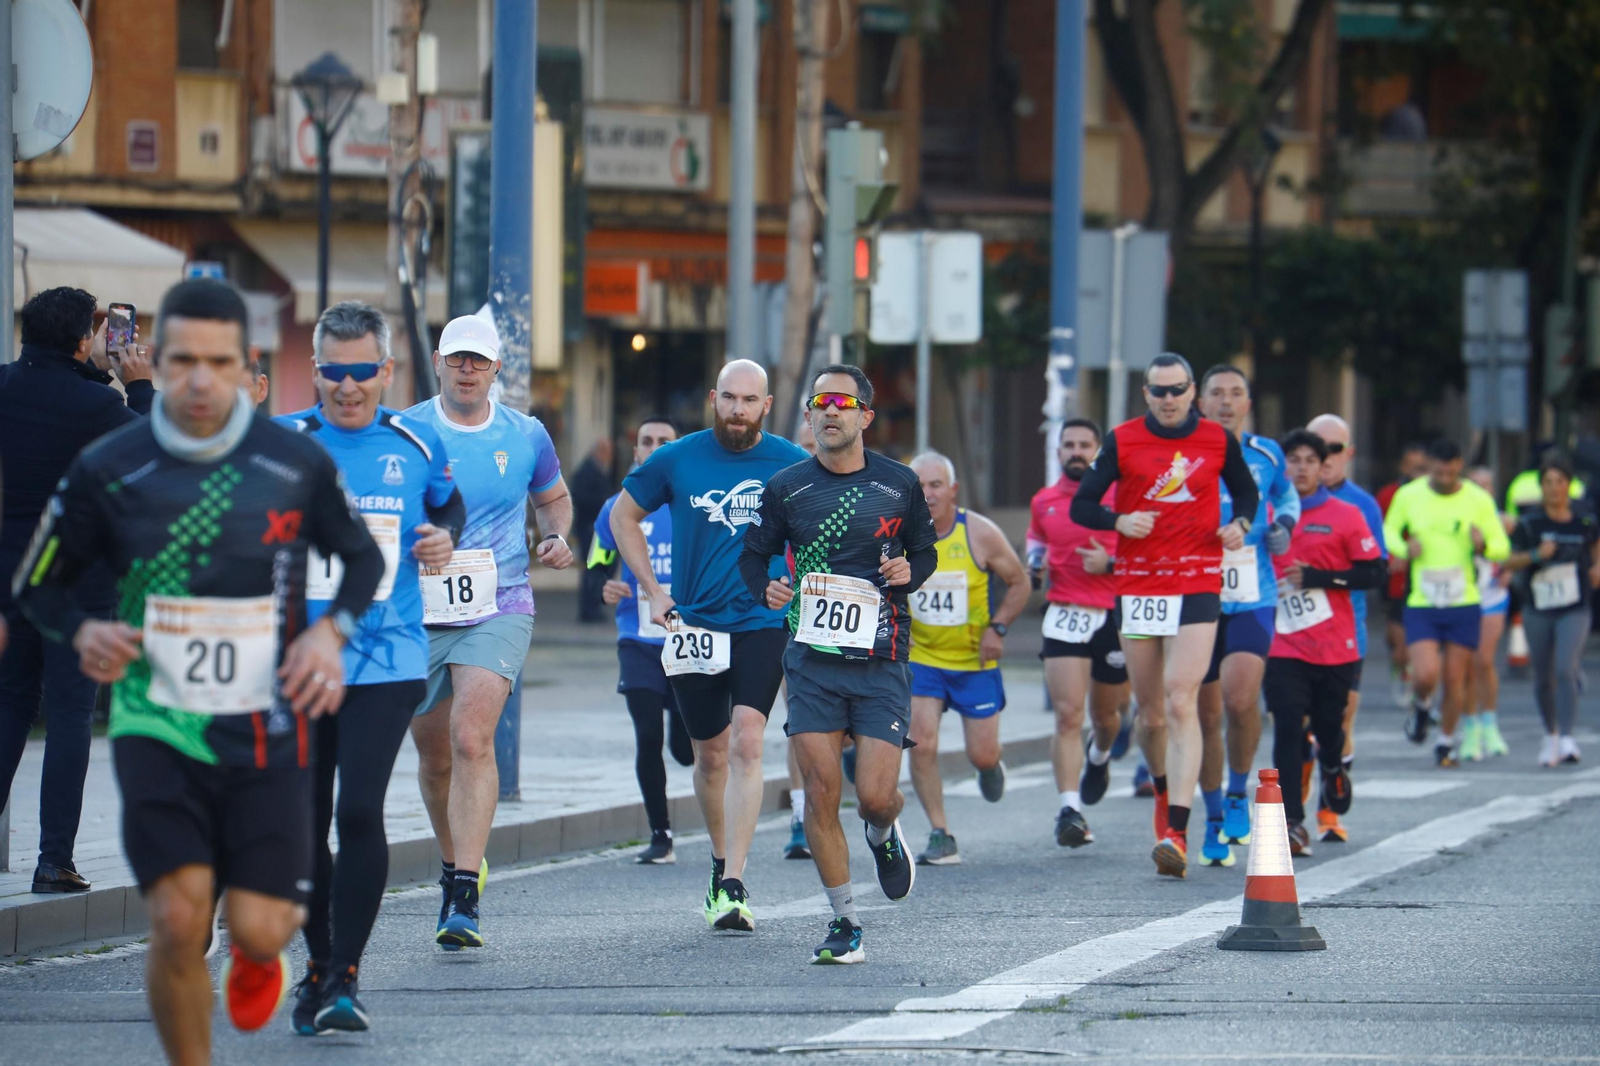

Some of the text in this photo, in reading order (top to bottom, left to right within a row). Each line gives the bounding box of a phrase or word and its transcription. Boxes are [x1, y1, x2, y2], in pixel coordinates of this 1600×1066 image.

[731, 494, 759, 509] XVIII
[877, 483, 901, 498] IMDECO
[352, 496, 404, 511] SIERRA
[729, 508, 749, 517] LEGUA
[873, 516, 903, 538] XI
[442, 575, 473, 605] 18
[804, 575, 828, 597] XLI
[917, 591, 954, 612] 244
[1131, 597, 1168, 621] 269
[1282, 590, 1316, 619] 195
[813, 598, 862, 634] 260
[1055, 608, 1091, 634] 263
[672, 632, 714, 660] 239
[186, 639, 236, 684] 20
